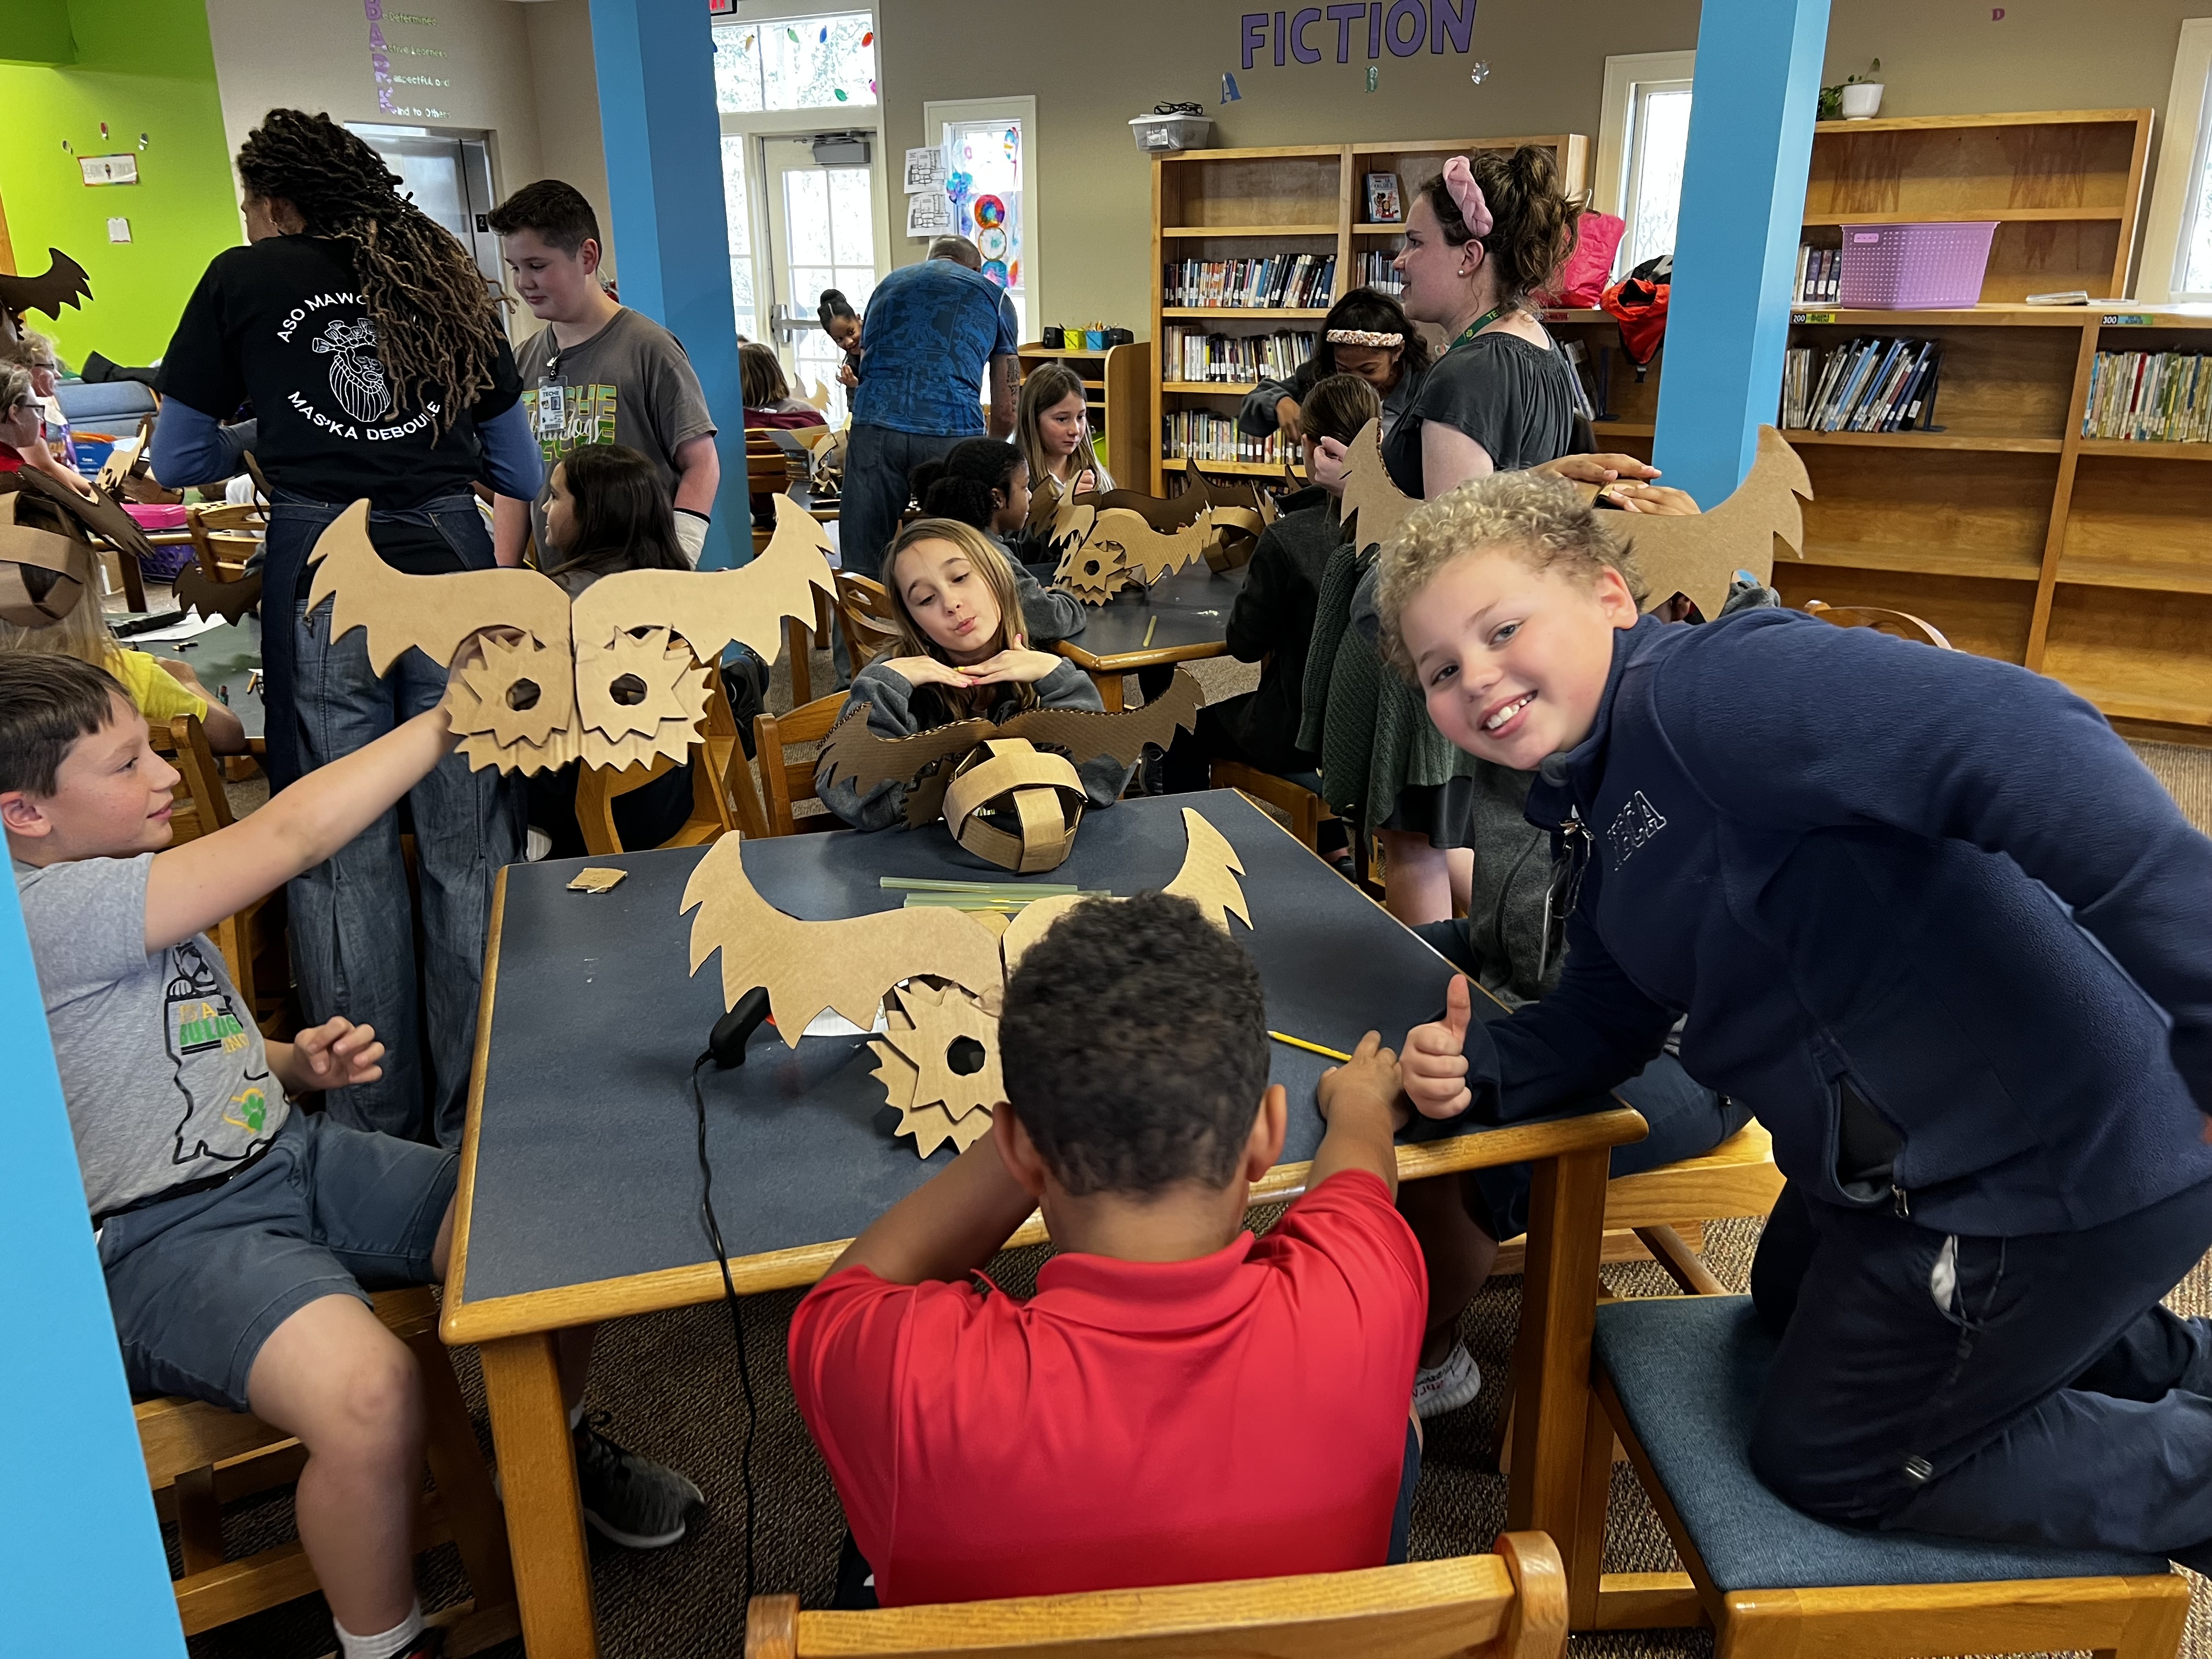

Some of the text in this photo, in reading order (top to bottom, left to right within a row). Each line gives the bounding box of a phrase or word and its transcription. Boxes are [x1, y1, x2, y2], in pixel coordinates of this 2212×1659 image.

[1991, 8, 2005, 21] D
[1242, 0, 1476, 69] FICTION
[411, 45, 447, 58] Learners
[1364, 66, 1379, 93] B
[1220, 71, 1242, 105] A
[413, 108, 422, 116] to
[425, 108, 452, 119] Others
[479, 216, 484, 227] 2
[1793, 314, 1805, 323] 200
[2103, 316, 2117, 324] 300
[277, 309, 305, 343] ASO
[366, 401, 441, 441] DEBOUE
